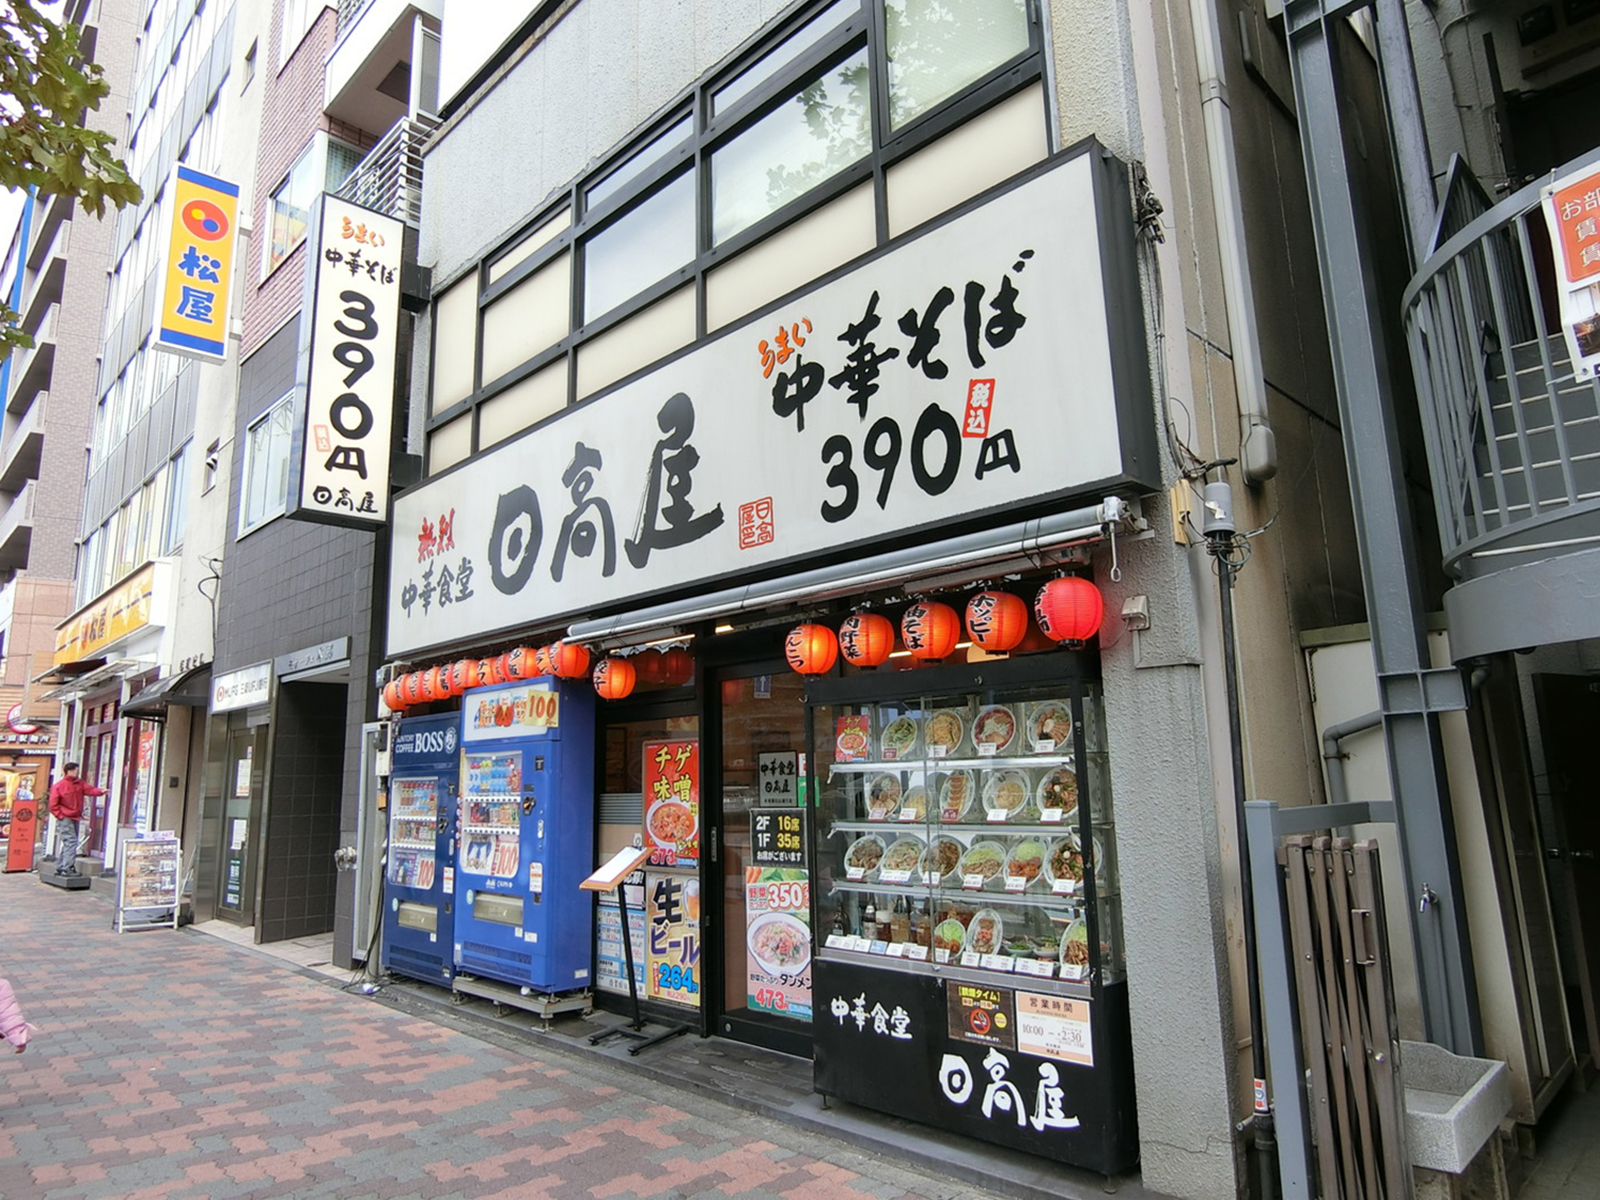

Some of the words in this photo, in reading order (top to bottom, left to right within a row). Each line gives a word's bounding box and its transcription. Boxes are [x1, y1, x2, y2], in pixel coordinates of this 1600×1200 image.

[341, 216, 386, 248] うまい
[325, 247, 398, 285] 中華そば
[176, 246, 222, 325] 松屋
[758, 317, 813, 378] うまい
[772, 249, 1035, 433] 中華そば
[820, 402, 1021, 524] 390円
[313, 485, 378, 513] 日高屋
[487, 392, 725, 596] 日高屋
[401, 557, 474, 618] 中華食堂
[529, 695, 557, 719] 100
[395, 744, 414, 753] COFFEE
[414, 731, 444, 753] BOSS
[655, 744, 692, 773] チゲ
[761, 758, 795, 776] 中華食堂
[653, 774, 692, 802] 味噌
[765, 779, 791, 793] 日高屋
[756, 816, 771, 830] 2F
[777, 816, 800, 832] 16席
[757, 833, 771, 847] 1F
[777, 833, 800, 849] 35席
[417, 859, 435, 888] 100
[497, 844, 518, 876] 100
[652, 877, 682, 925] 生
[651, 922, 700, 966] ビール
[830, 992, 913, 1039] 中華食堂
[1029, 997, 1073, 1013] 営業時間
[1022, 1023, 1044, 1036] 10:00
[938, 1046, 1081, 1132] 日高屋
